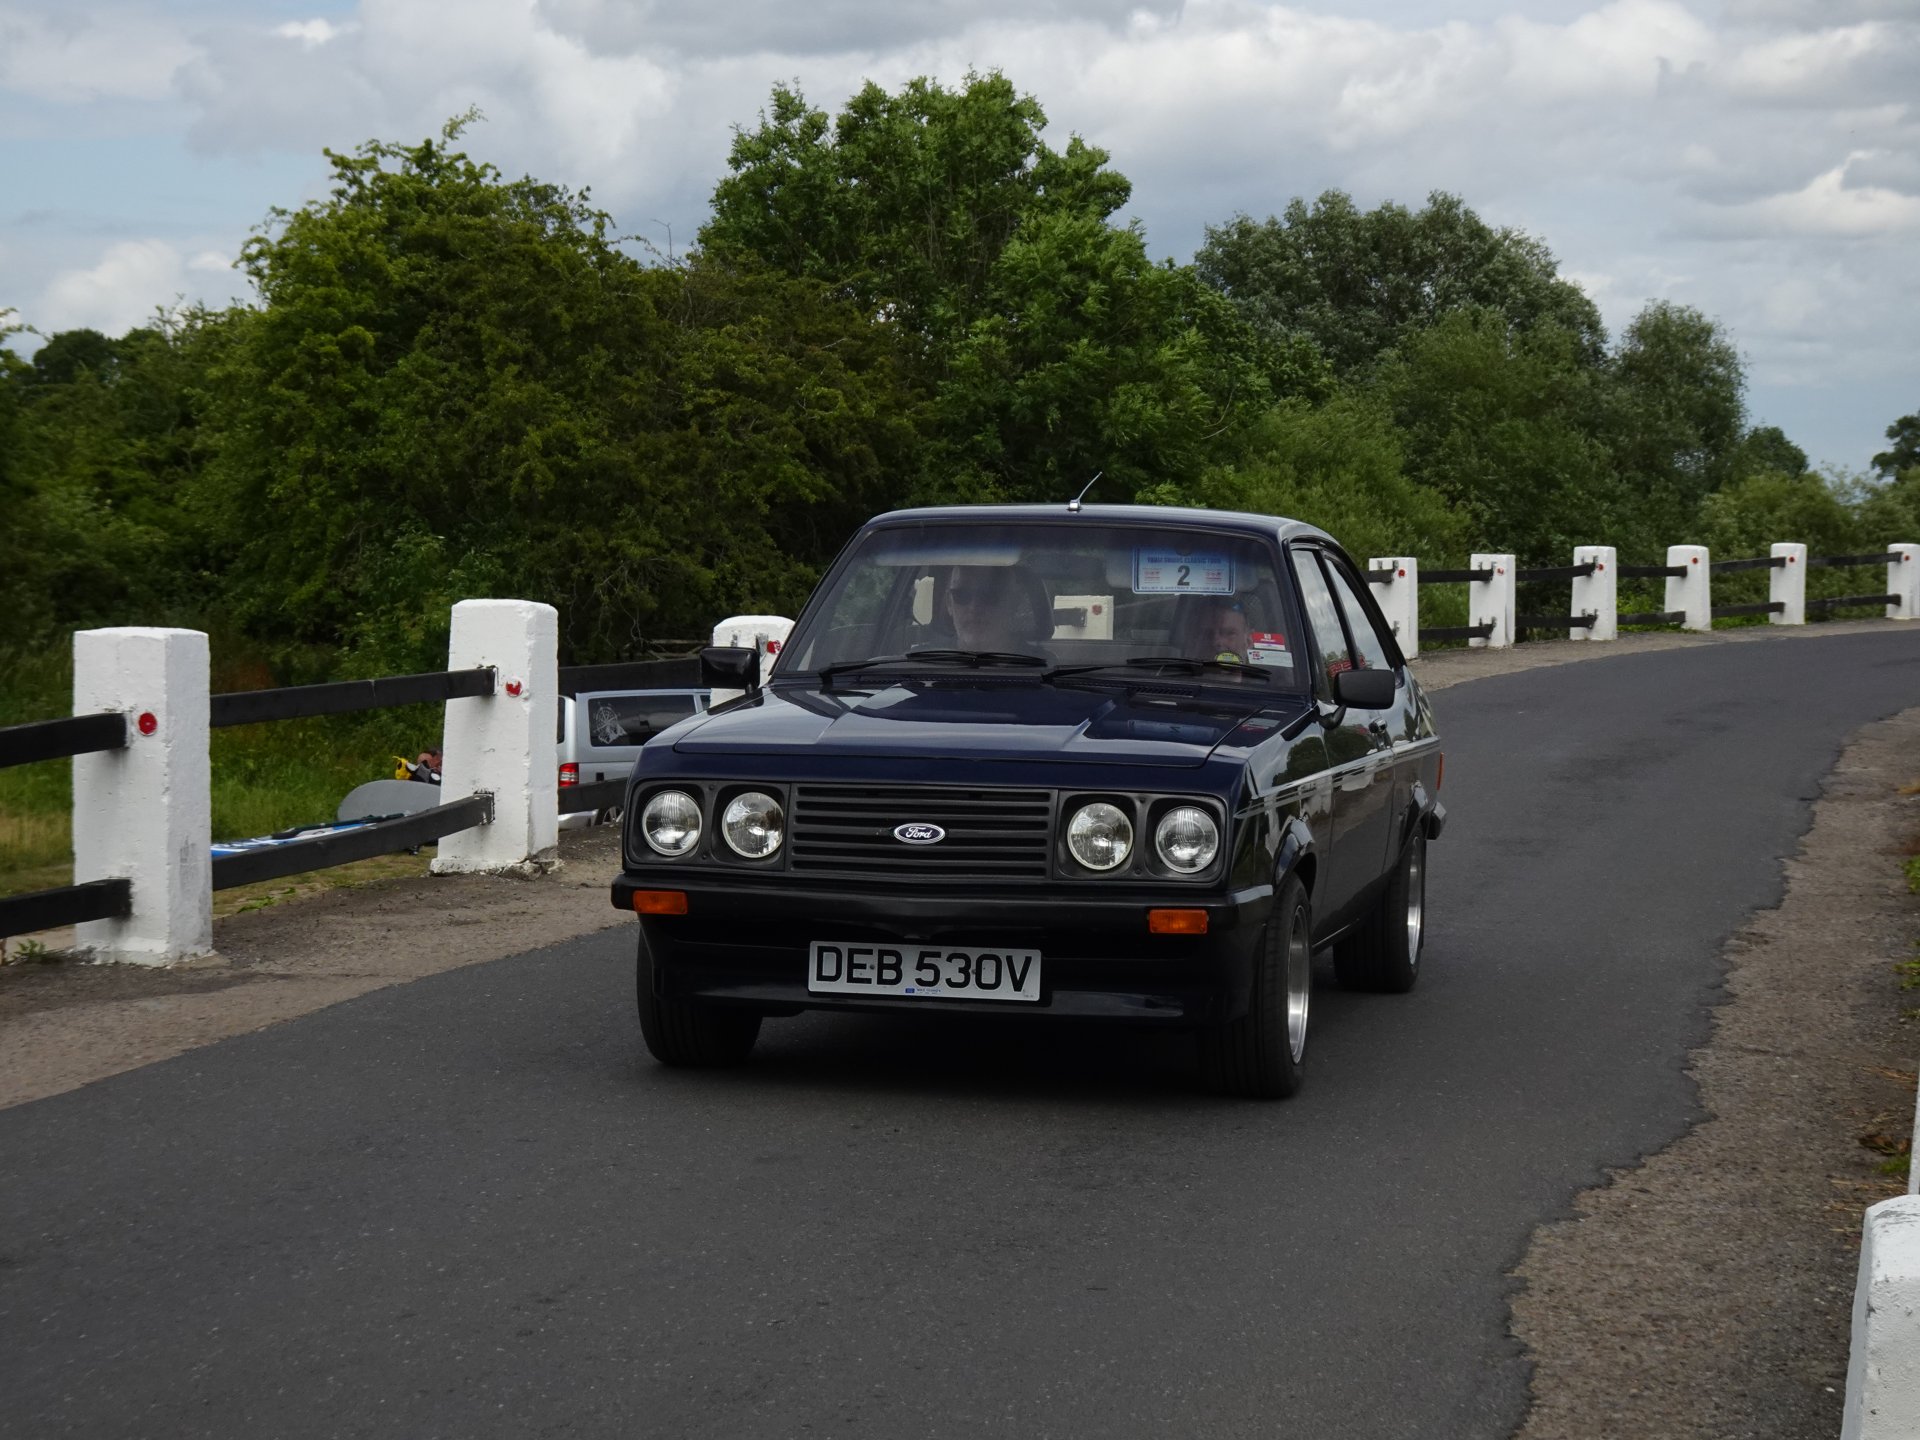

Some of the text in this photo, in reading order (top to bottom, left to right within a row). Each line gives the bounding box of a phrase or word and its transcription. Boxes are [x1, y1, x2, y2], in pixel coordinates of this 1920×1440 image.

[1177, 565, 1190, 586] 2
[905, 826, 933, 838] Ford
[816, 945, 1032, 992] DEB 530V
